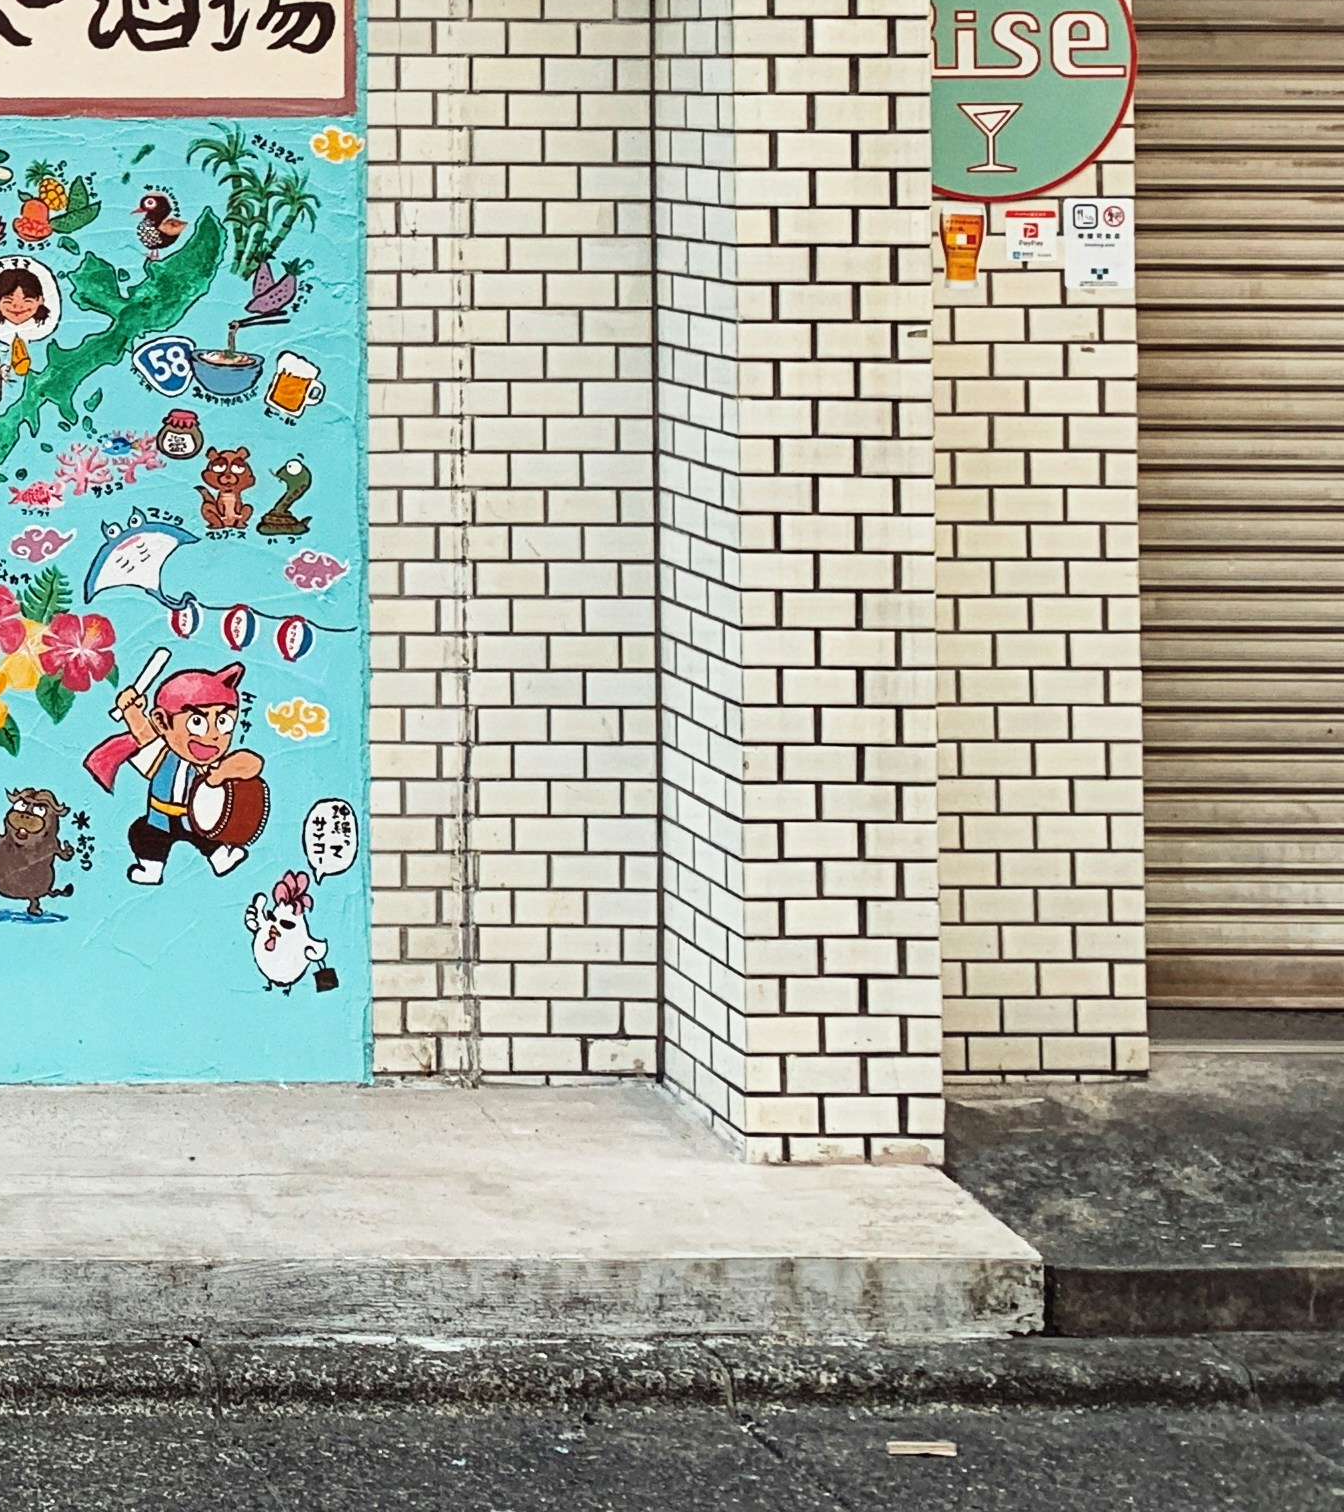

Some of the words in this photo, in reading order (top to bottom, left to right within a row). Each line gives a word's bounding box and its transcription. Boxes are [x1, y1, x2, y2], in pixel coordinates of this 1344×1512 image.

[147, 345, 191, 382] 58
[146, 506, 185, 526] マンタ
[240, 691, 258, 745] エイサー
